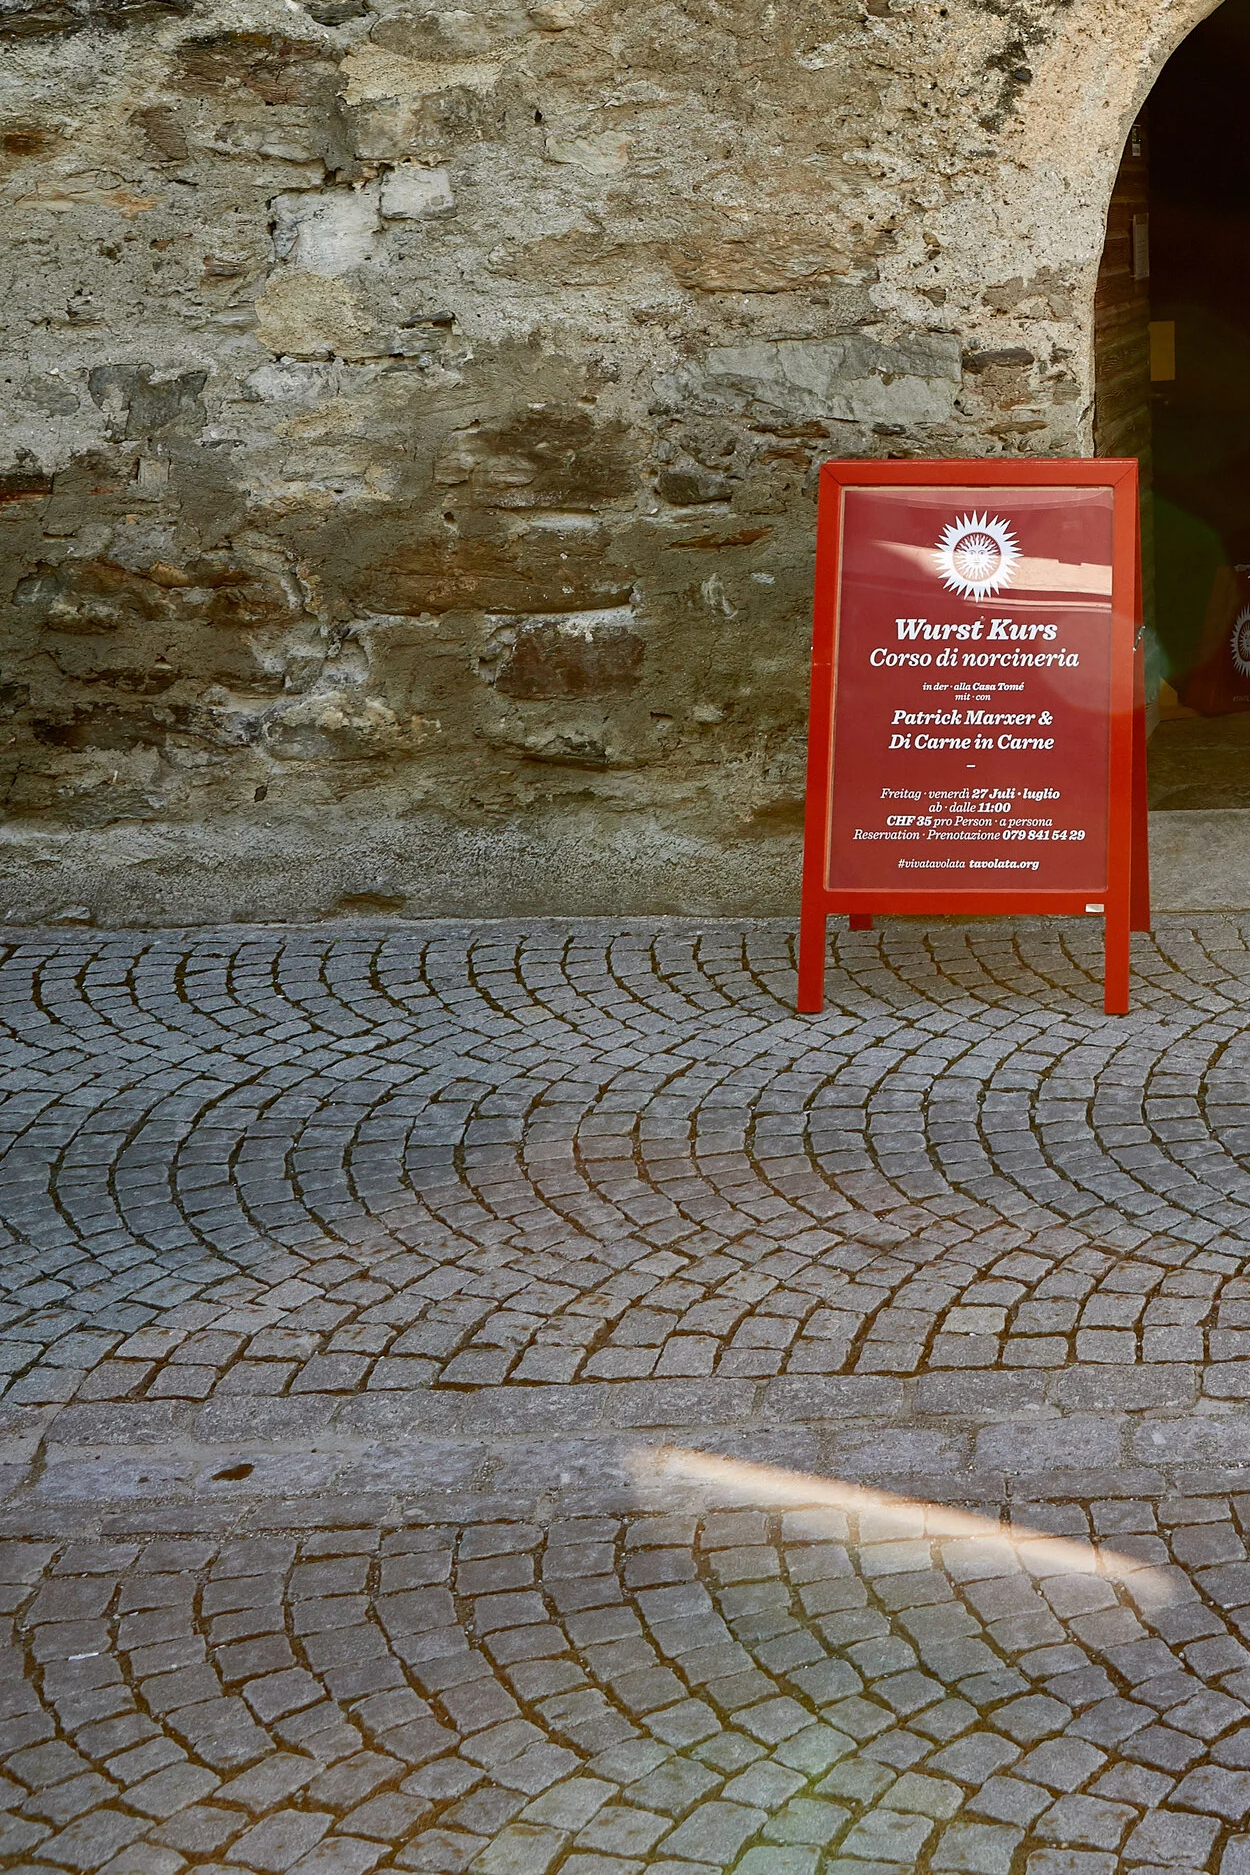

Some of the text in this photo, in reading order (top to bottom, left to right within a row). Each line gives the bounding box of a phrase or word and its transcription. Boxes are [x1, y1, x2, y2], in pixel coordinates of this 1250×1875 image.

[895, 618, 1058, 640] Wurst Kurs
[870, 648, 1079, 667] Corso di norcineria
[933, 682, 949, 690] der
[954, 682, 971, 690] alla
[998, 682, 1024, 690] Tomé
[891, 709, 1053, 725] Patrick Marxer &
[889, 733, 1054, 749] Di Carne in Carne
[880, 788, 1060, 800] Freitag venerdì 27 Juli luglio
[929, 802, 1011, 812] ab dalle 11:00
[887, 816, 916, 826] CHF
[916, 816, 932, 826] 35
[933, 819, 952, 828] pro
[954, 816, 992, 826] Person
[1008, 819, 1052, 828] persona
[853, 829, 1085, 840] Reservation Prenotazione 079 841 54 29
[898, 859, 1039, 870] #vivatavolata tavolata.org
